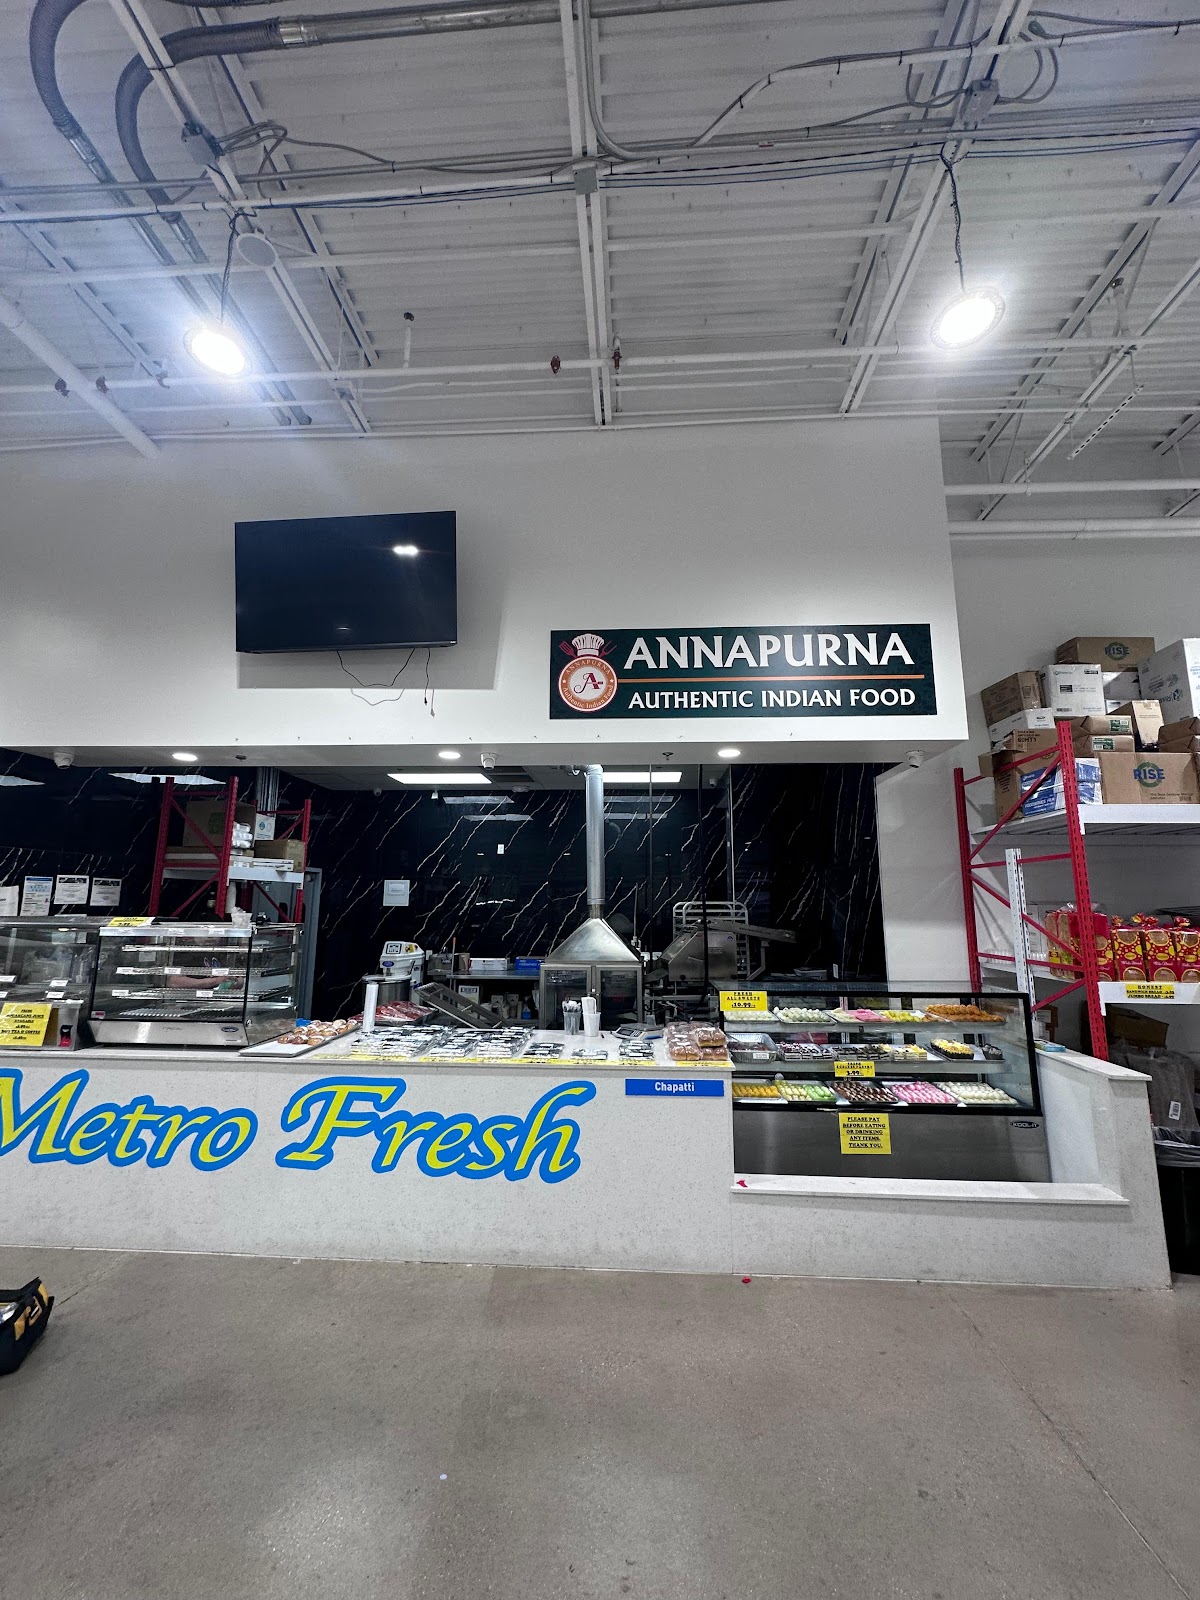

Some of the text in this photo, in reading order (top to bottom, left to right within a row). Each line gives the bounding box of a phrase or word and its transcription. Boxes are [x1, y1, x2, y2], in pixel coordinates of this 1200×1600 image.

[623, 633, 915, 669] ANNAPURNA
[1104, 645, 1130, 655] RISE
[565, 659, 611, 675] ANNAPURNA
[562, 684, 614, 709] Authentic Indian Food
[628, 688, 916, 709] AUTHENTIC INDIAN FOOD
[1133, 768, 1166, 780] RISE
[654, 1081, 695, 1093] Chapatti
[0, 1068, 596, 1183] Metro Fresh
